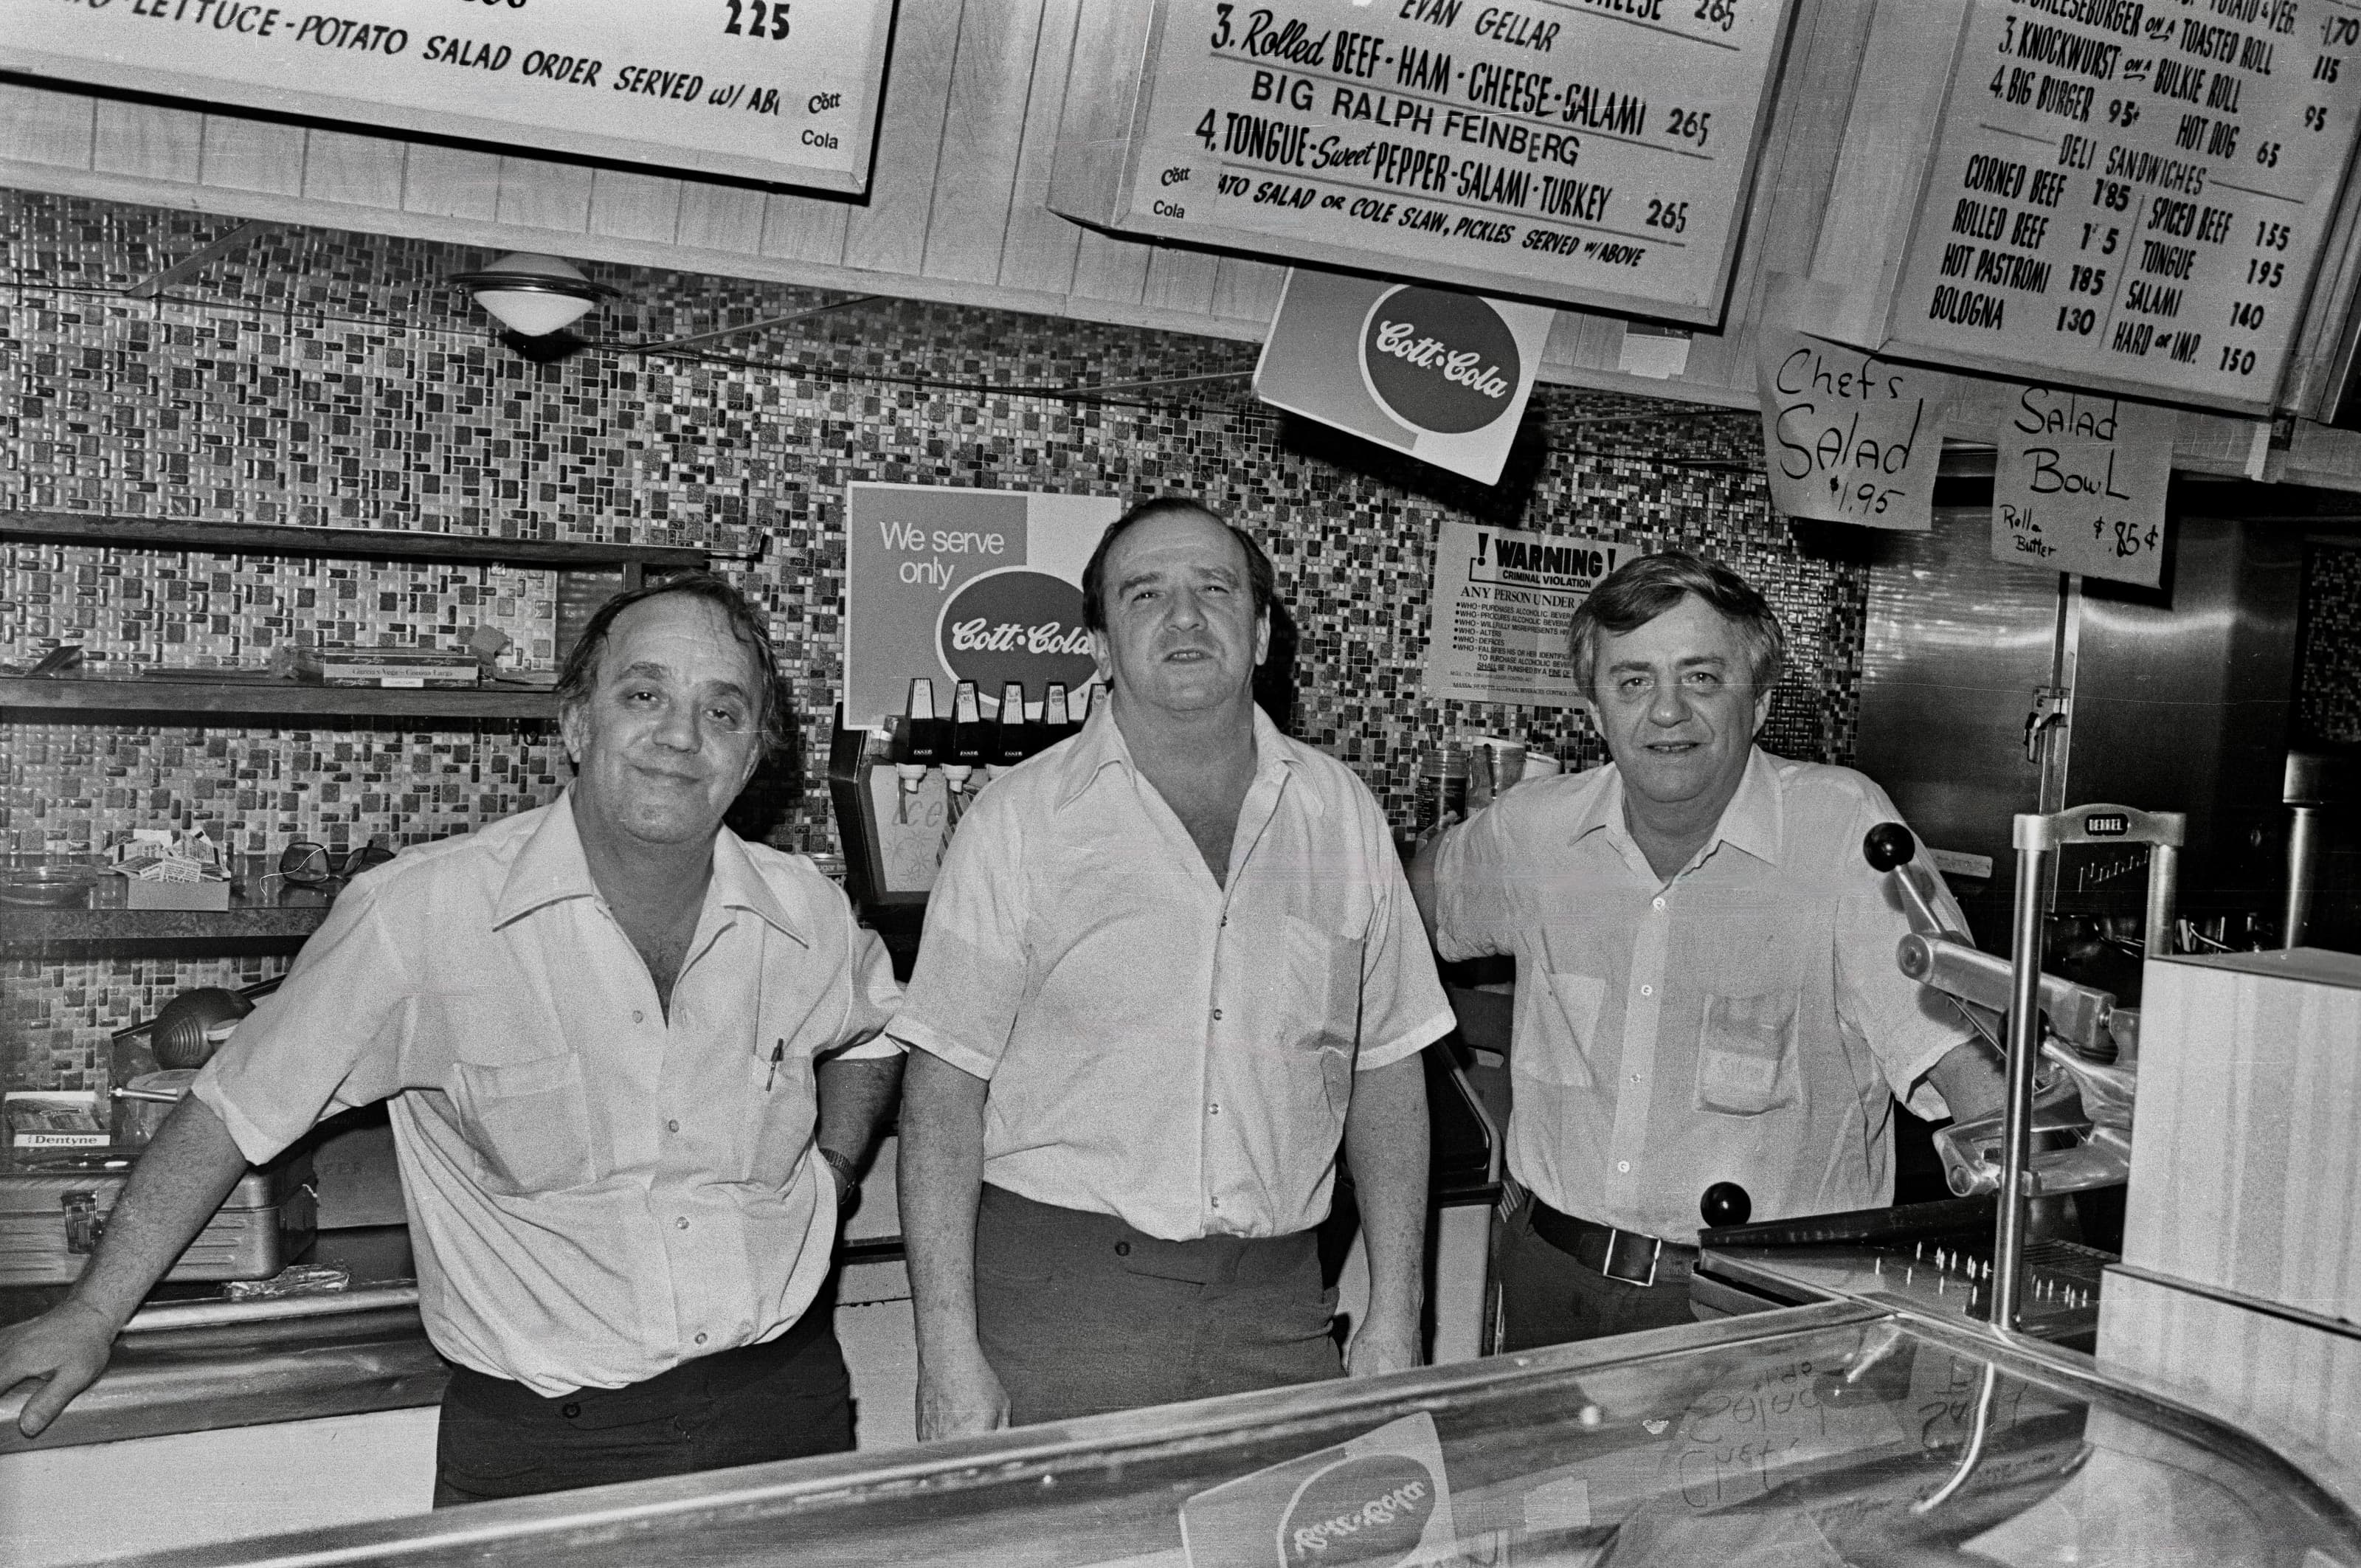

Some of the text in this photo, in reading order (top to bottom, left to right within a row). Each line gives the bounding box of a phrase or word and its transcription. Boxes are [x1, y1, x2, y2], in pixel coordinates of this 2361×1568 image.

[725, 0, 790, 40] 225
[1400, 0, 1464, 28] EVAN
[1475, 7, 1560, 52] GELLAR
[423, 35, 512, 72] SALAD
[522, 50, 602, 86] ORDER
[614, 66, 703, 102] SERVED
[747, 87, 781, 115] AB
[1211, 3, 1236, 49] 3.
[1241, 10, 1330, 66] Rolled
[1332, 30, 1384, 78] BEEF
[1397, 45, 1451, 94] HAM
[1666, 108, 1711, 147] 265
[2017, 21, 2122, 80] KNOCKWURST
[2154, 58, 2206, 104] BULKIE
[2207, 74, 2242, 114] ROLL
[2305, 106, 2327, 131] 95
[2179, 18, 2240, 64] TOASTED
[2239, 37, 2273, 75] ROLL
[2312, 55, 2342, 84] 115
[801, 129, 839, 150] Cola
[1251, 71, 1580, 166] BIG RALPH FEINBERG
[2006, 66, 2032, 106] BIG
[2036, 75, 2095, 123] BURGER
[2176, 114, 2209, 150] HOT
[2208, 121, 2240, 159] DOG
[2256, 141, 2281, 168] 65
[1195, 108, 1217, 152] 4.
[1541, 176, 1612, 222] TURKEY
[1645, 199, 1689, 233] 265
[1964, 153, 2027, 200] CORNED
[2028, 169, 2067, 208] BEEF
[2058, 133, 2208, 196] DELI SANDWICHES
[1152, 200, 1186, 219] Cola
[1254, 182, 1316, 210] SALAD
[1350, 198, 1394, 224] COLE
[1398, 207, 1451, 237] SLAW,
[1453, 217, 1516, 244] PICKLES
[1522, 229, 1580, 257] SERVED
[1952, 198, 2008, 241] ROLLED
[2011, 212, 2049, 250] BEEF
[2148, 196, 2290, 252] SPICED BEEF 155
[1940, 243, 1975, 278] HOT
[1974, 249, 2052, 294] PASTROMI
[2140, 240, 2285, 288] TONGUE 195
[1929, 285, 2096, 336] BOLOGNA 130
[2126, 280, 2264, 331] SALAMI 140
[2112, 321, 2154, 356] HARD
[2219, 346, 2256, 375] 150
[879, 521, 1005, 555] We serve
[899, 556, 955, 590] only
[1460, 586, 1491, 598] ANY
[1494, 588, 1532, 604] PERSON
[1533, 594, 1575, 609] UNDER
[1503, 570, 1591, 588] CRIMINAL VIOLATION
[1459, 618, 1476, 626] WHO
[1459, 627, 1476, 635] WHO
[1460, 609, 1476, 618] WHO
[1461, 601, 1477, 609] WHO
[1515, 607, 1548, 618] ALCOHOLIC
[35, 1135, 98, 1147] Dentyne
